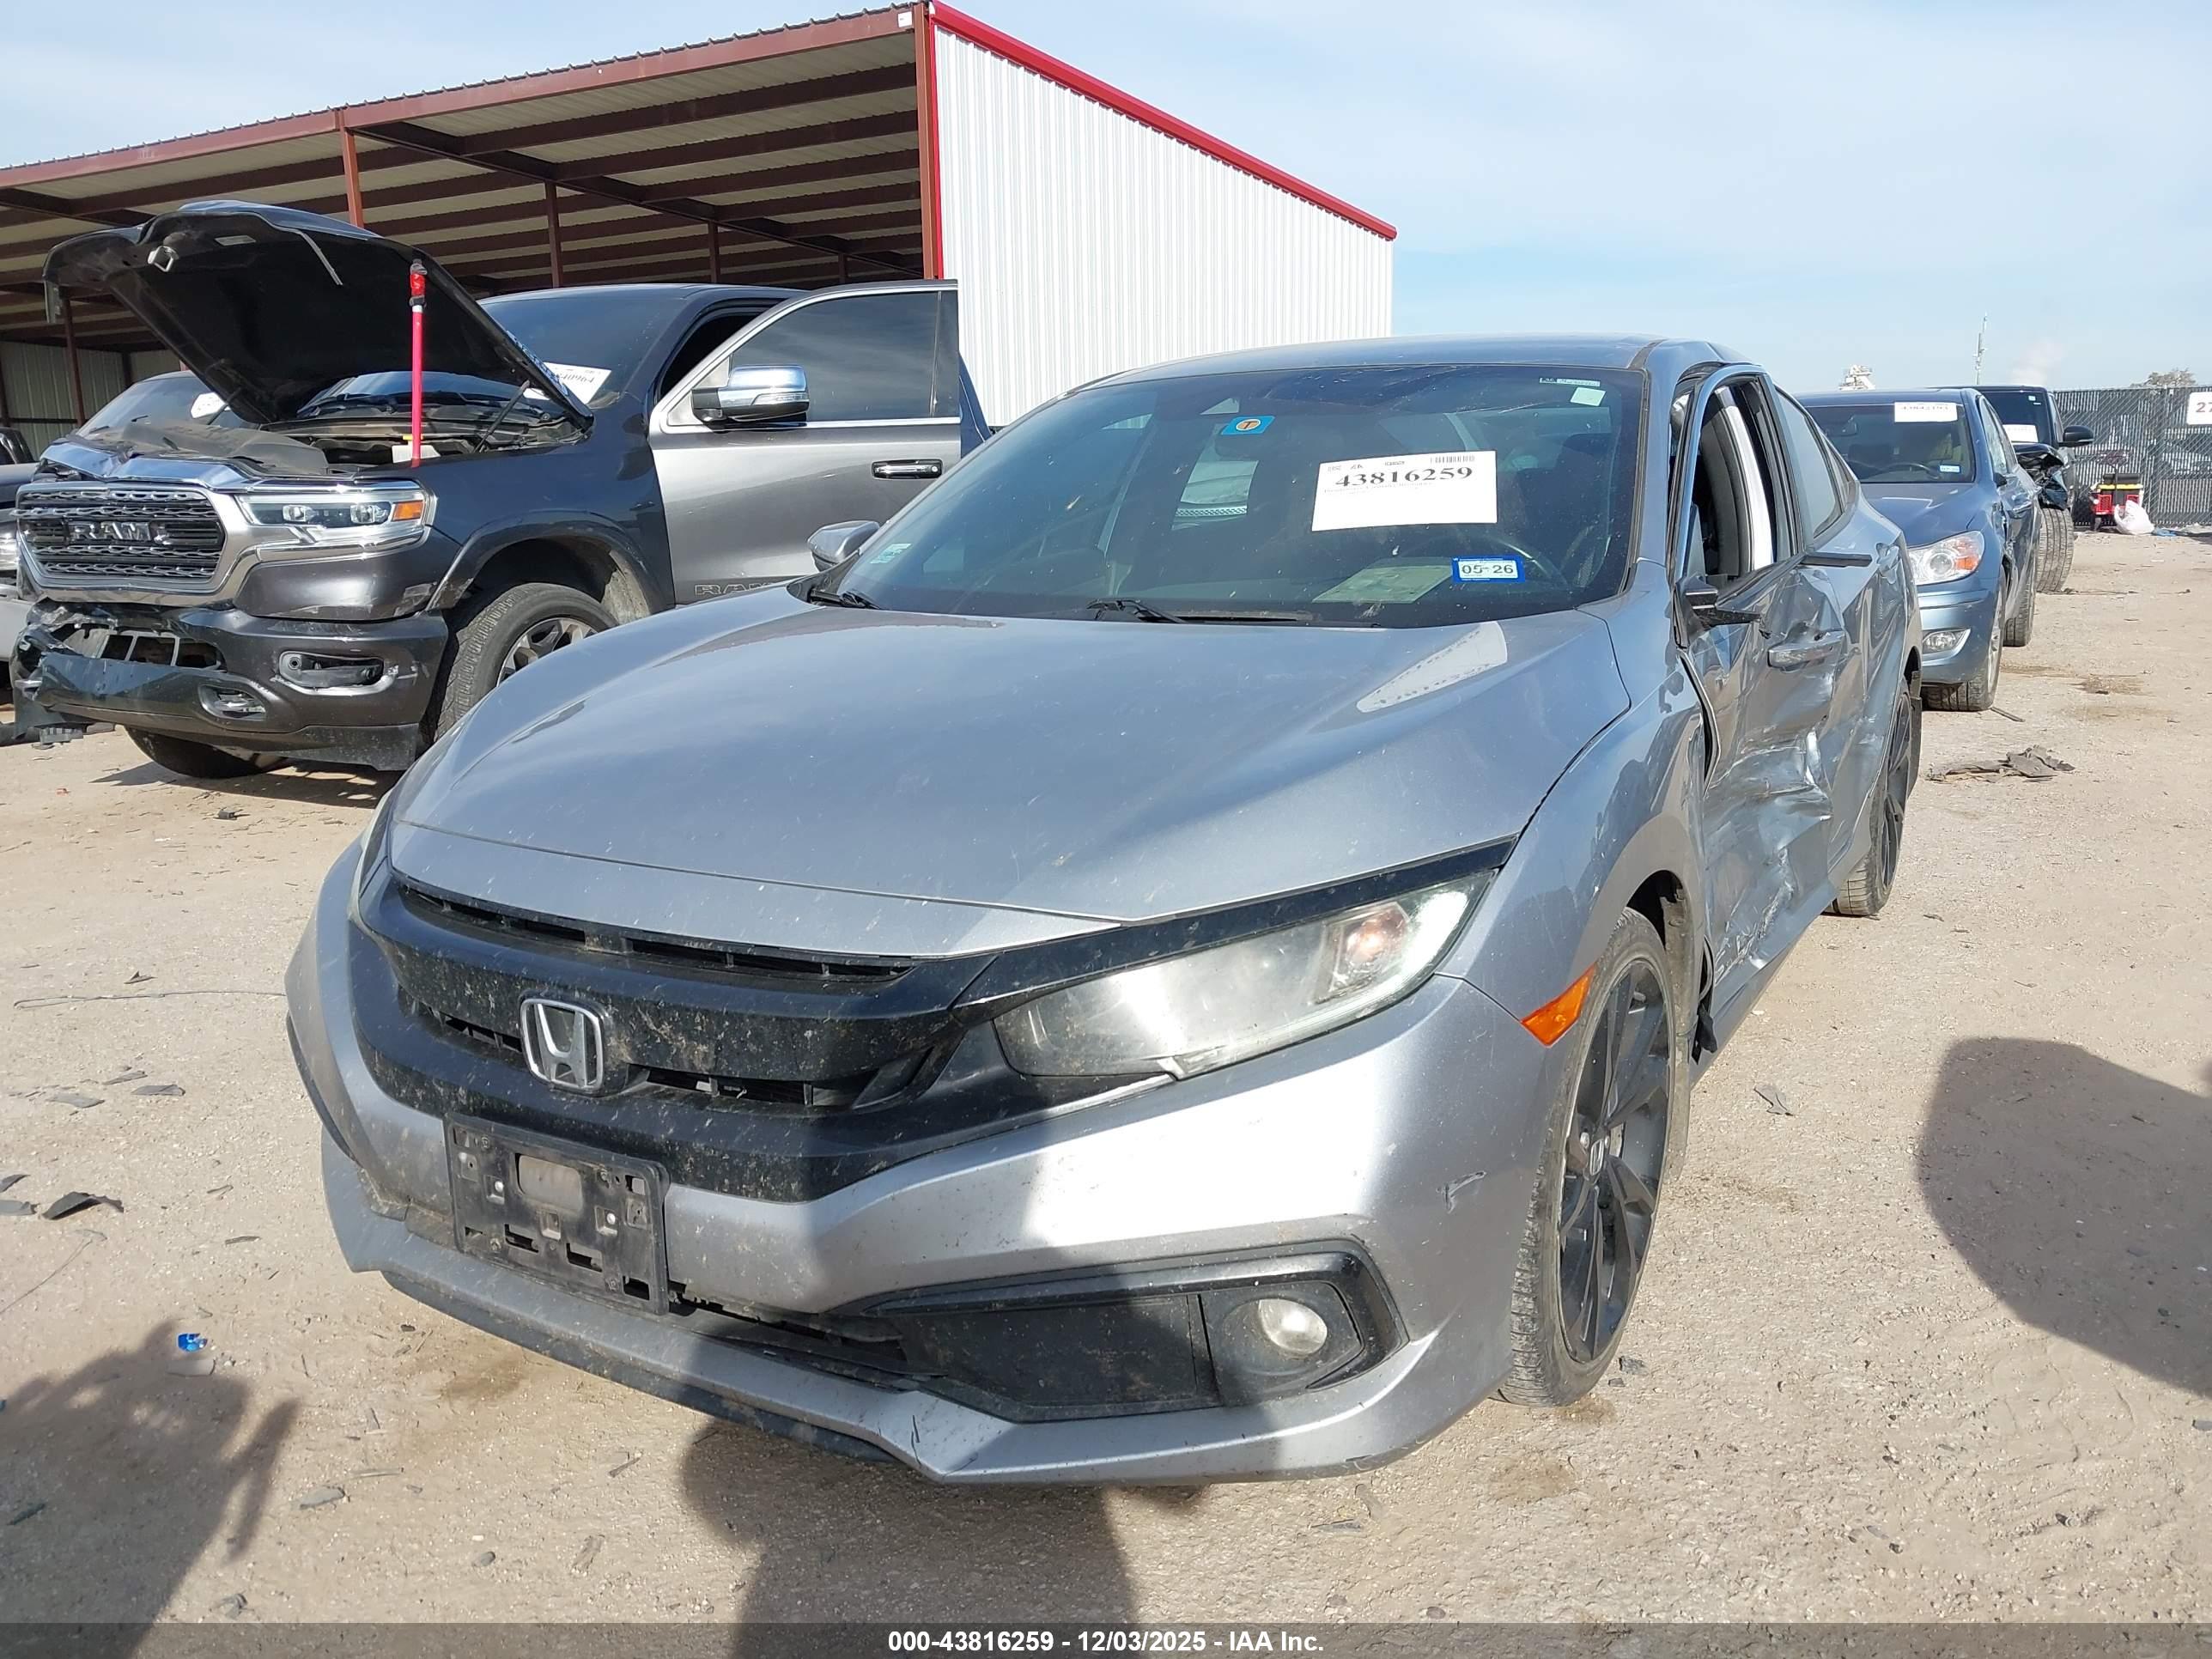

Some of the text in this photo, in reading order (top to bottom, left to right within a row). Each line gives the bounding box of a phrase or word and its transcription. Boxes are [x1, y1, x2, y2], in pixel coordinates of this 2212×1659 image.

[1335, 466, 1474, 487] 43816259
[69, 521, 151, 540] RAM
[1462, 564, 1514, 574] 05 26
